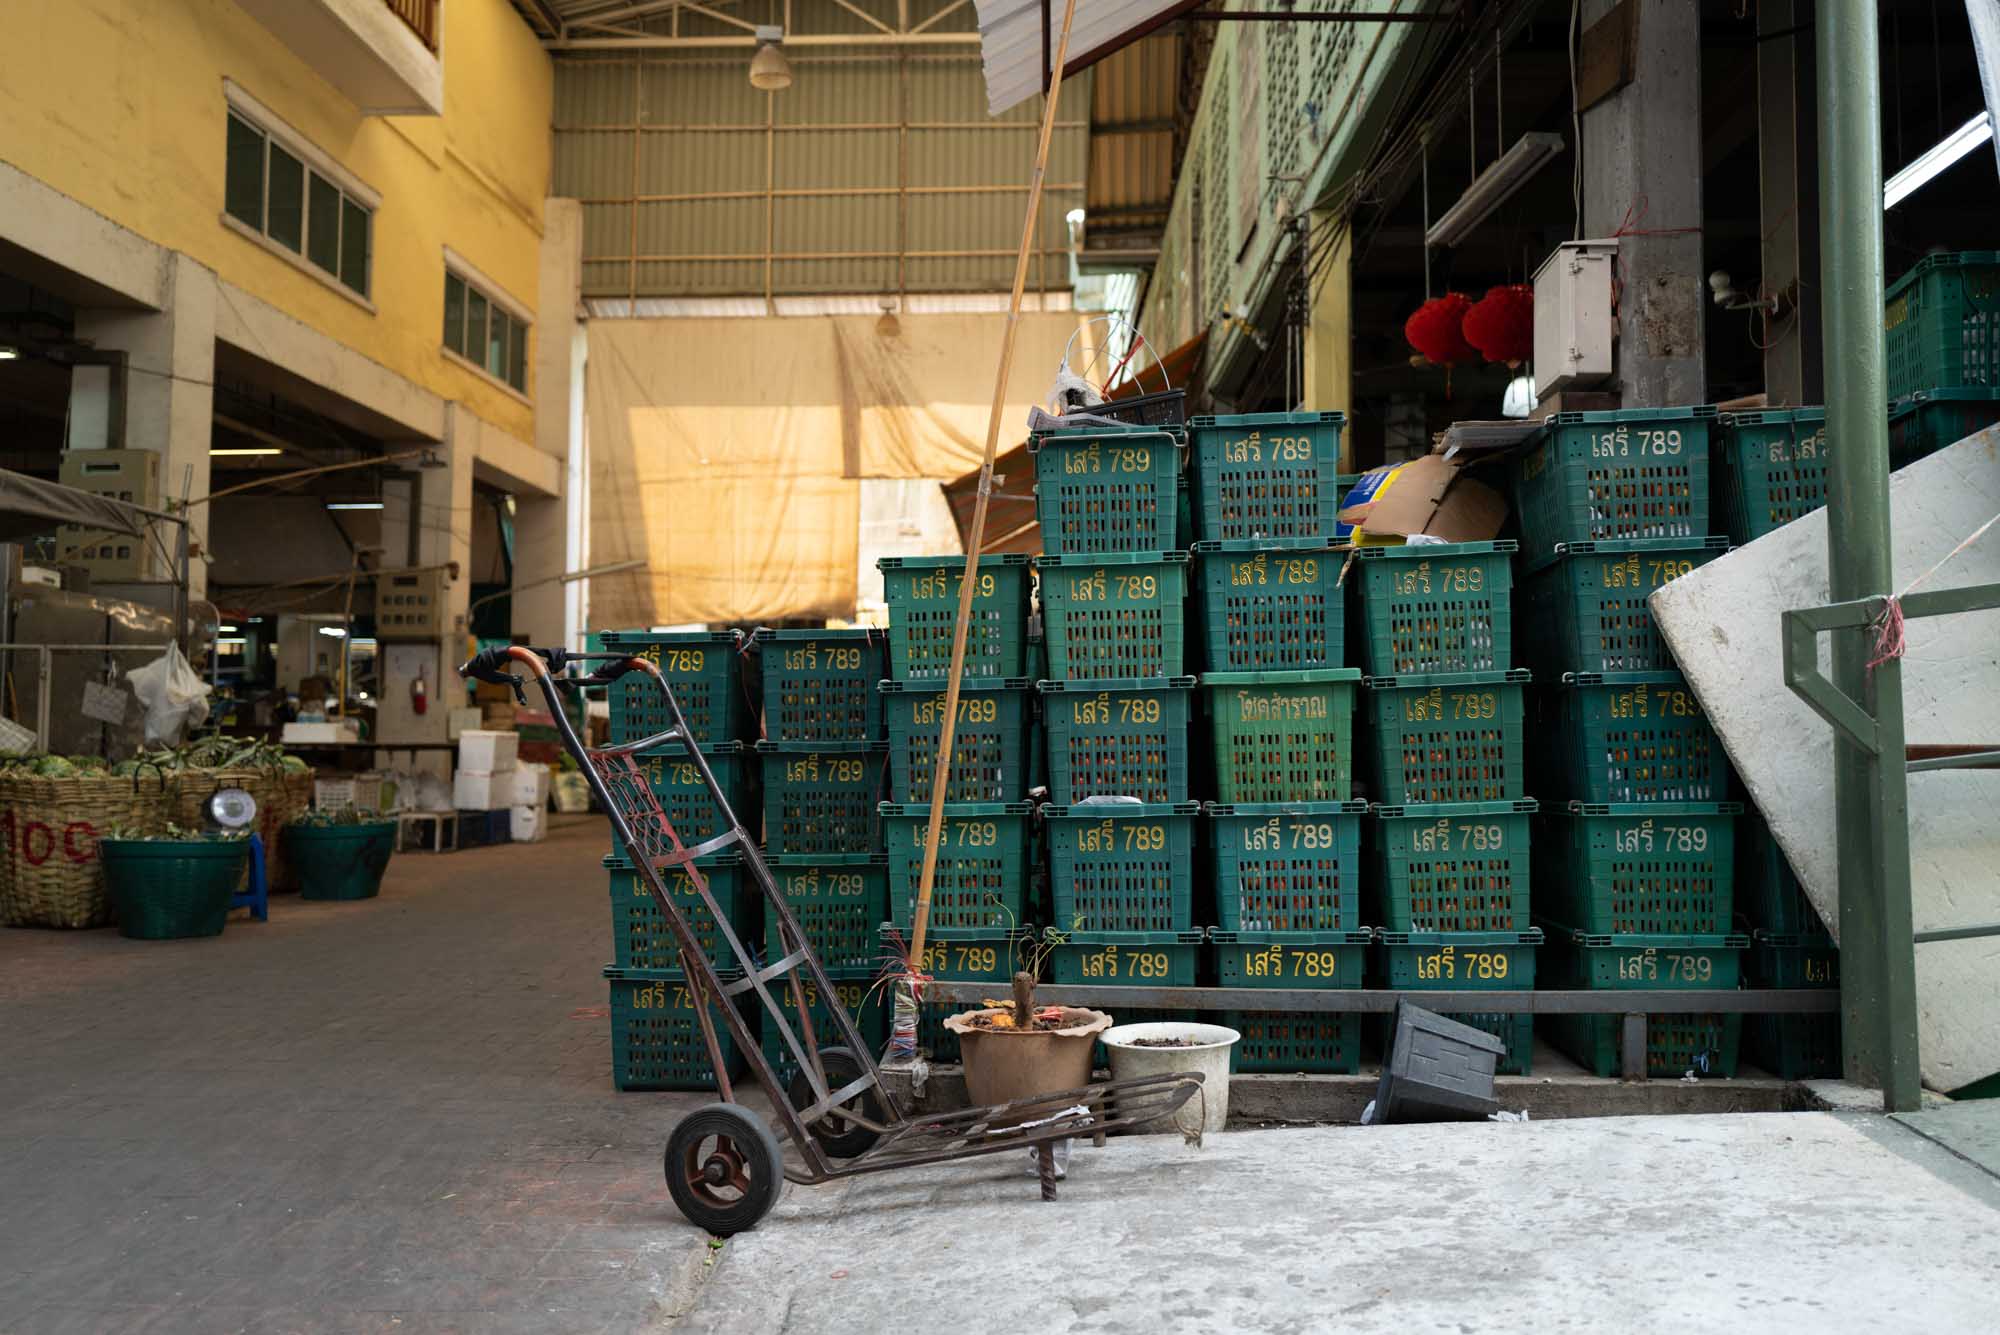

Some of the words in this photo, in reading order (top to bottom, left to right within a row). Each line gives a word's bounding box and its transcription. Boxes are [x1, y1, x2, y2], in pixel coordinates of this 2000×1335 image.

[1226, 432, 1261, 463] เสรี
[1269, 437, 1311, 461] 789
[1591, 426, 1629, 457] เสรี
[1638, 431, 1682, 455] 789
[1064, 442, 1100, 474] เสรี
[1108, 448, 1150, 472] 789
[912, 569, 946, 599] เสรี
[1071, 570, 1106, 601] เสรี
[1115, 576, 1156, 599] 789
[1231, 554, 1267, 586] เสรี
[1276, 560, 1319, 584] 789
[1395, 563, 1432, 594] เสรี
[1440, 567, 1483, 592] 789
[1603, 555, 1640, 587] เสรี
[631, 644, 661, 671] สรี
[667, 650, 704, 671] 789
[786, 642, 817, 669] เสรี
[824, 648, 861, 669] 789
[956, 698, 997, 722] 789
[1074, 693, 1109, 724] เสรี
[1118, 699, 1160, 723] 789
[1405, 689, 1442, 721] เสรี
[1451, 694, 1495, 719] 789
[1610, 685, 1648, 718] เสรี
[632, 757, 663, 785] สรี
[787, 754, 820, 782] เสรี
[826, 760, 863, 782] 789
[956, 822, 997, 846] 789
[1078, 819, 1114, 852] เสรี
[1122, 826, 1165, 850] 789
[1245, 818, 1281, 850] เสรี
[1289, 824, 1333, 849] 789
[1413, 819, 1450, 851] เสรี
[1459, 825, 1502, 850] 789
[1616, 820, 1654, 852] เสรี
[1662, 827, 1708, 852] 789
[787, 870, 820, 896] เสรี
[825, 874, 864, 896] 789
[920, 941, 947, 971] สรี
[955, 947, 996, 971] 789
[1082, 946, 1118, 977] เสรี
[1126, 953, 1168, 977] 789
[1246, 946, 1282, 976] เสรี
[1290, 952, 1334, 977] 789
[1418, 947, 1454, 978] เสรี
[1463, 953, 1508, 978] 789
[1619, 949, 1657, 980] เสรี
[1666, 955, 1712, 981] 789
[633, 982, 666, 1008] เสรี
